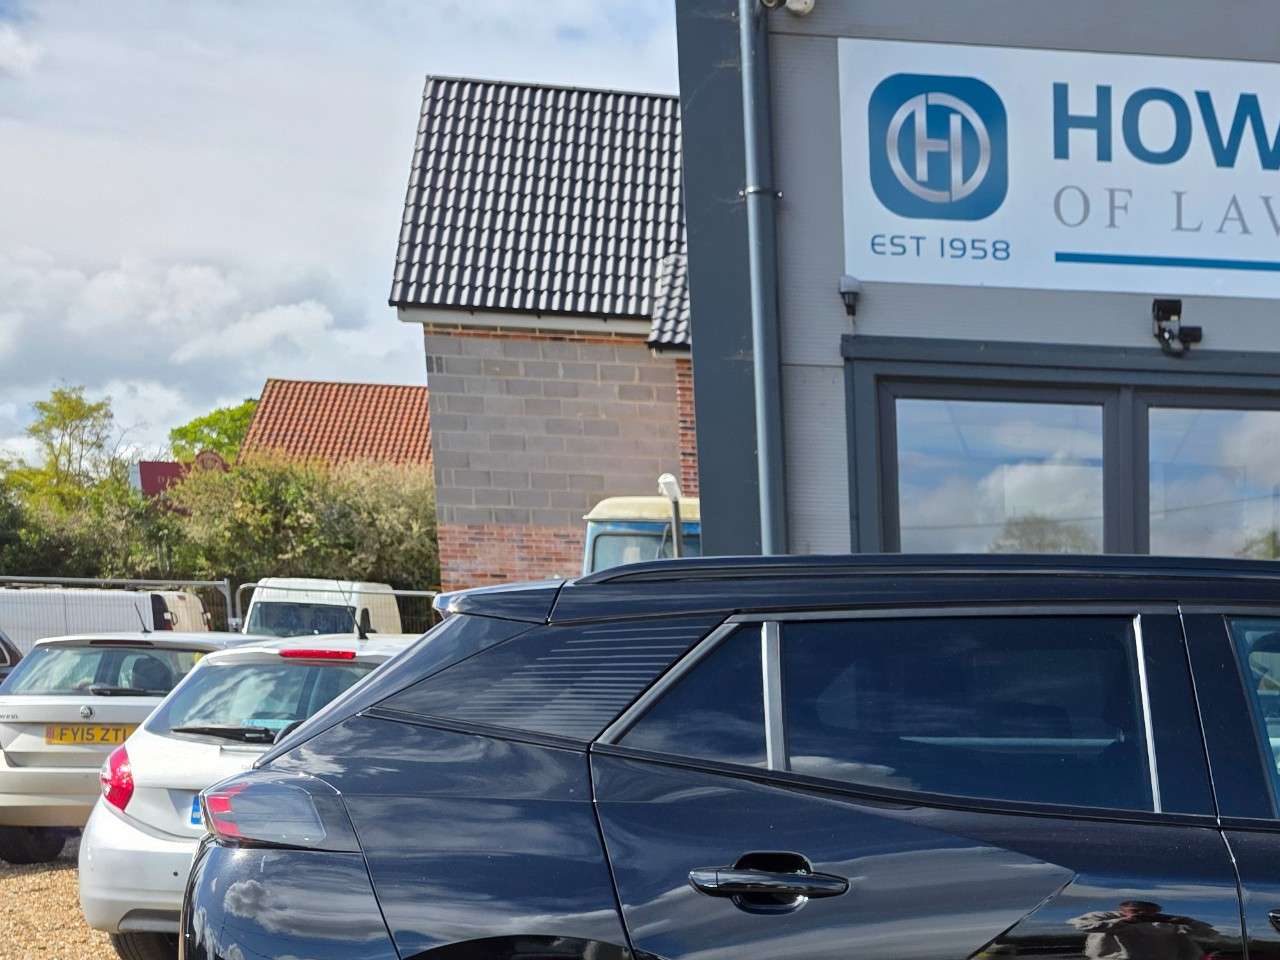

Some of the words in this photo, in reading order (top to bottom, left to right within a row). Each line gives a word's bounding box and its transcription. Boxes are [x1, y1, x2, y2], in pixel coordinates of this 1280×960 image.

[1052, 184, 1134, 230] OF
[870, 233, 927, 257] EST
[939, 237, 1011, 262] 1958
[59, 727, 95, 742] FY15
